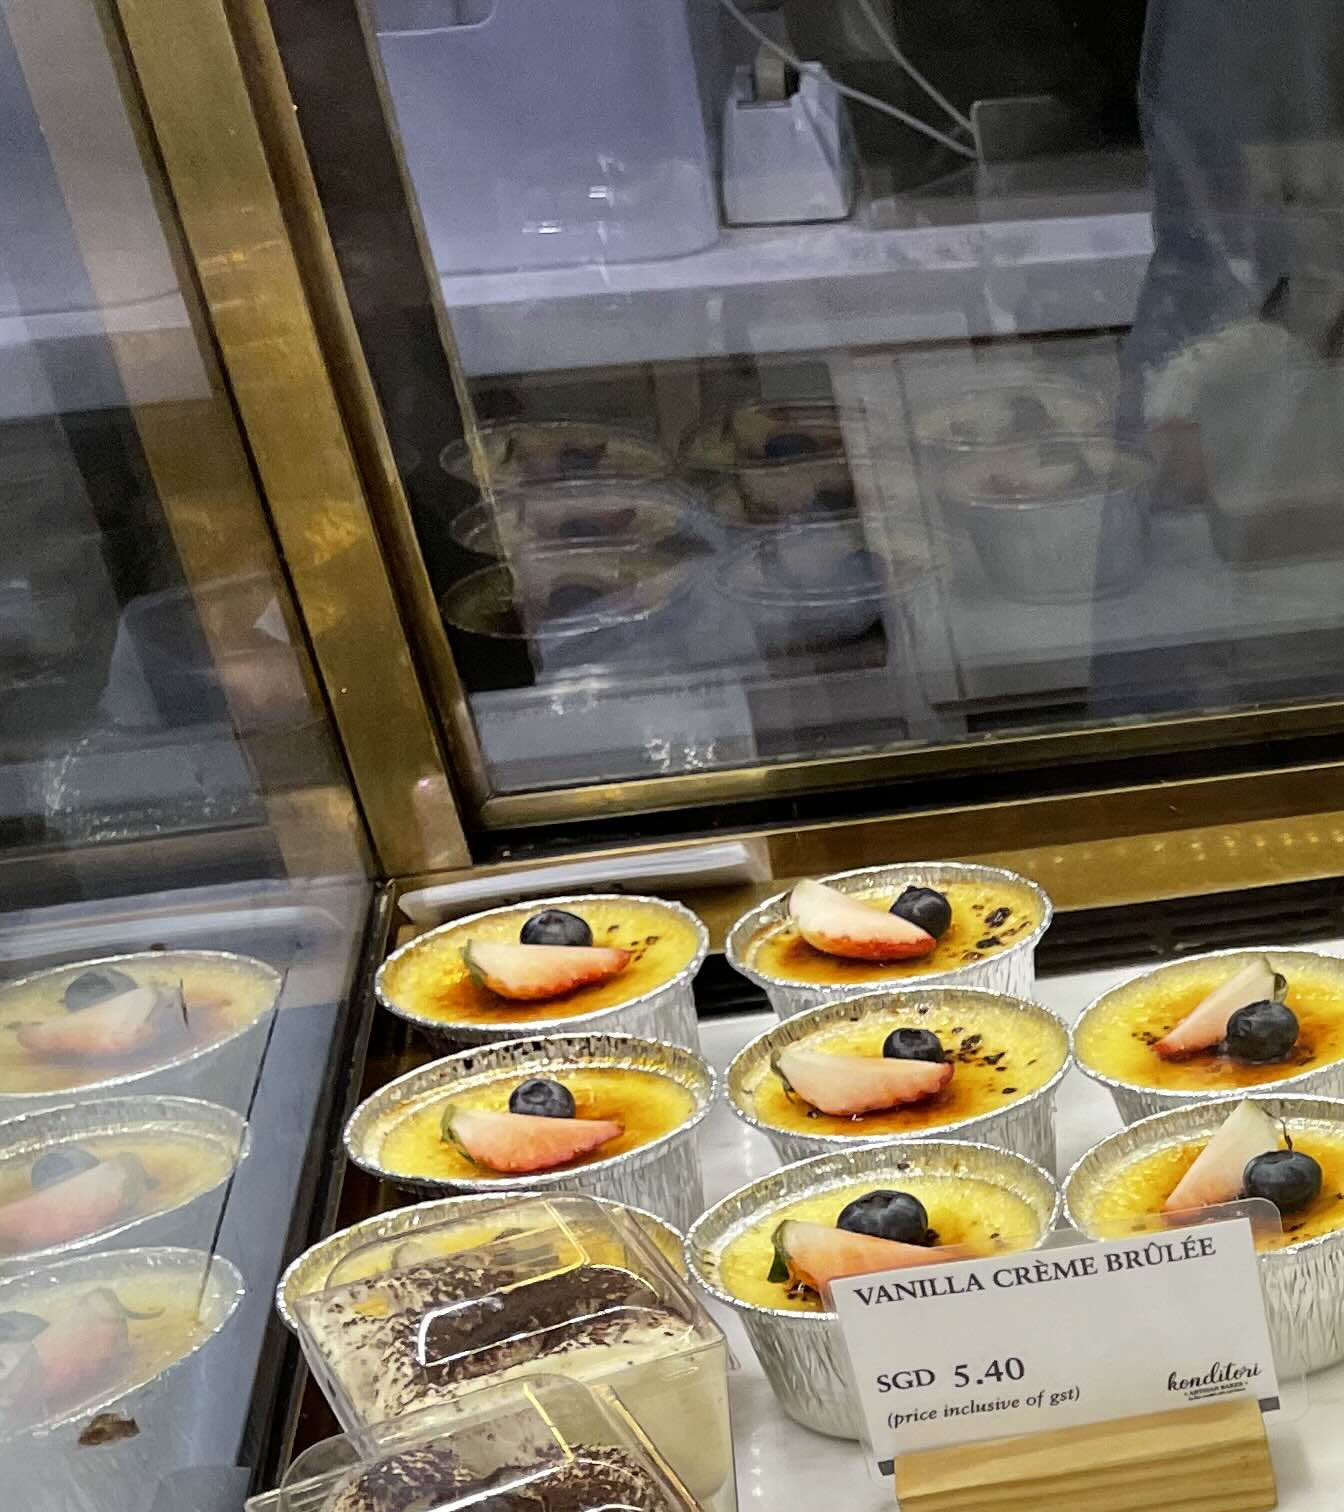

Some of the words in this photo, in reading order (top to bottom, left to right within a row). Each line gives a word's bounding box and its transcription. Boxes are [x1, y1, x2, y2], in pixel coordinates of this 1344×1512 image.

[854, 1273, 986, 1306] VANILLA
[992, 1255, 1098, 1289] CRÈME
[1104, 1235, 1217, 1272] BRÛLÉE
[876, 1368, 935, 1393] SGD
[954, 1357, 1025, 1388] 5.40
[1168, 1362, 1262, 1391] konditori
[887, 1408, 938, 1429] (price
[943, 1395, 1020, 1417] inclusive
[1025, 1389, 1046, 1407] of
[1049, 1386, 1080, 1407] gst)
